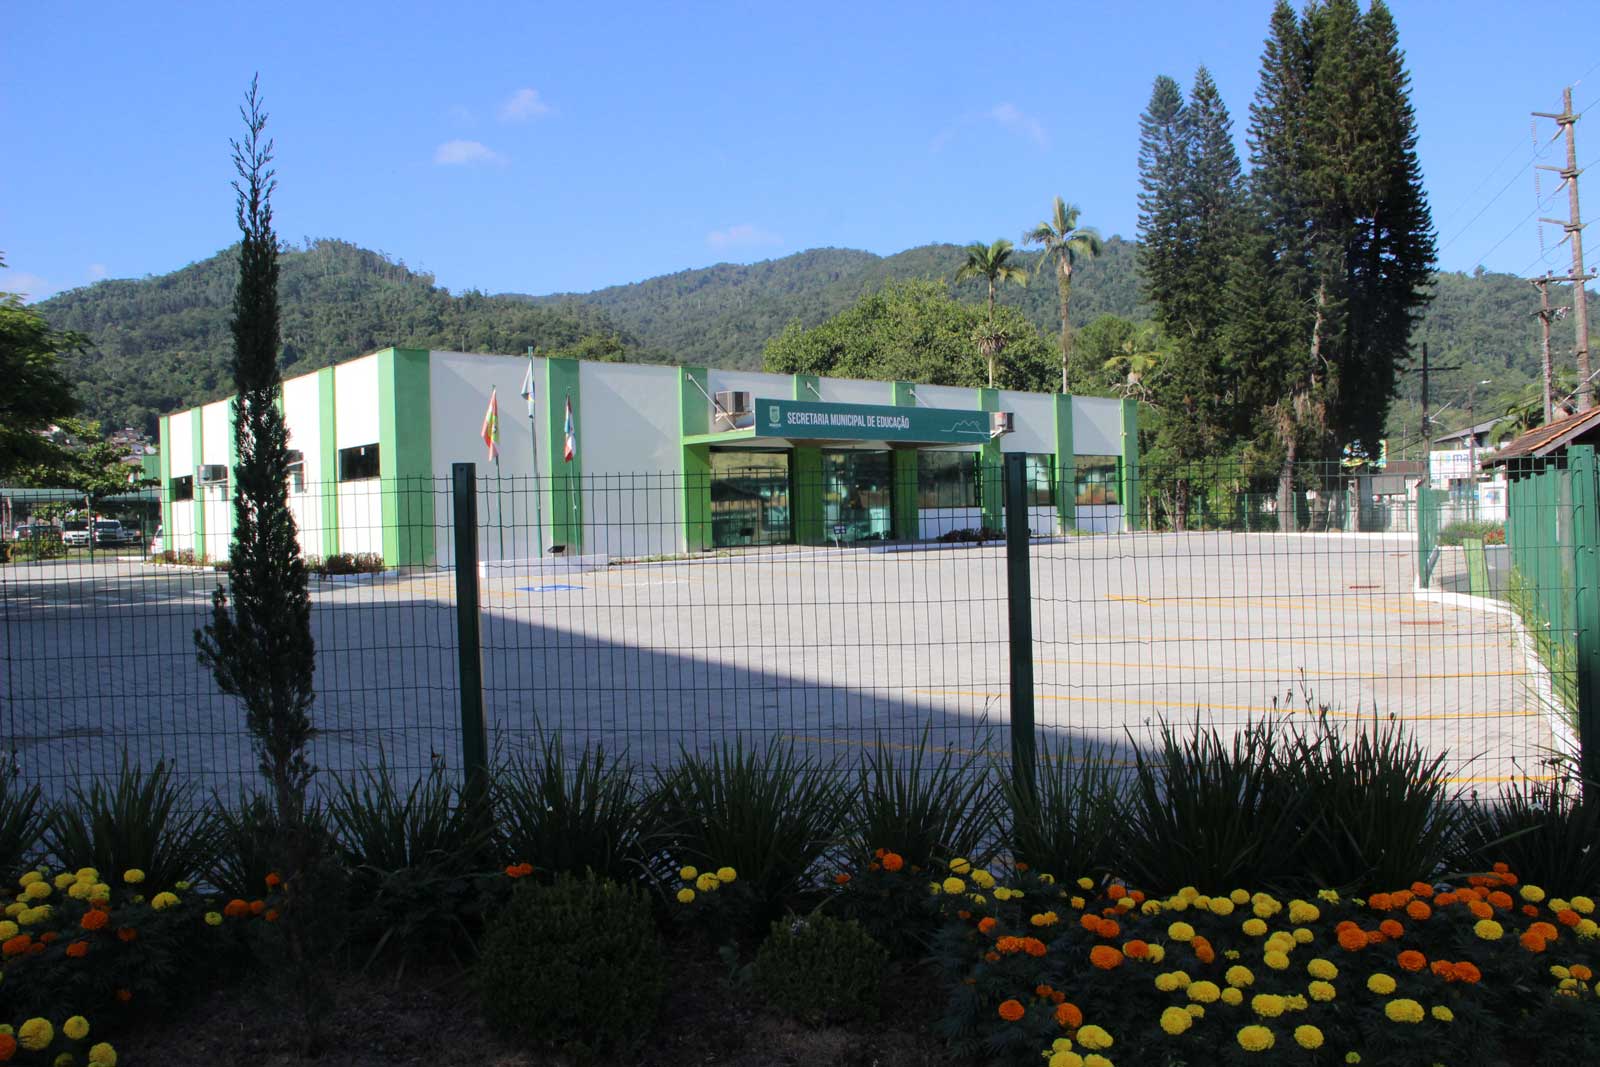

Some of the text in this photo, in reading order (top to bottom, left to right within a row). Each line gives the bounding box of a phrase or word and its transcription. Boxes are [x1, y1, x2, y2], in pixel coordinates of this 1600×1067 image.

[787, 412, 909, 430] SECRETARIA MUNICIPAL DE EDUCAÇÃO
